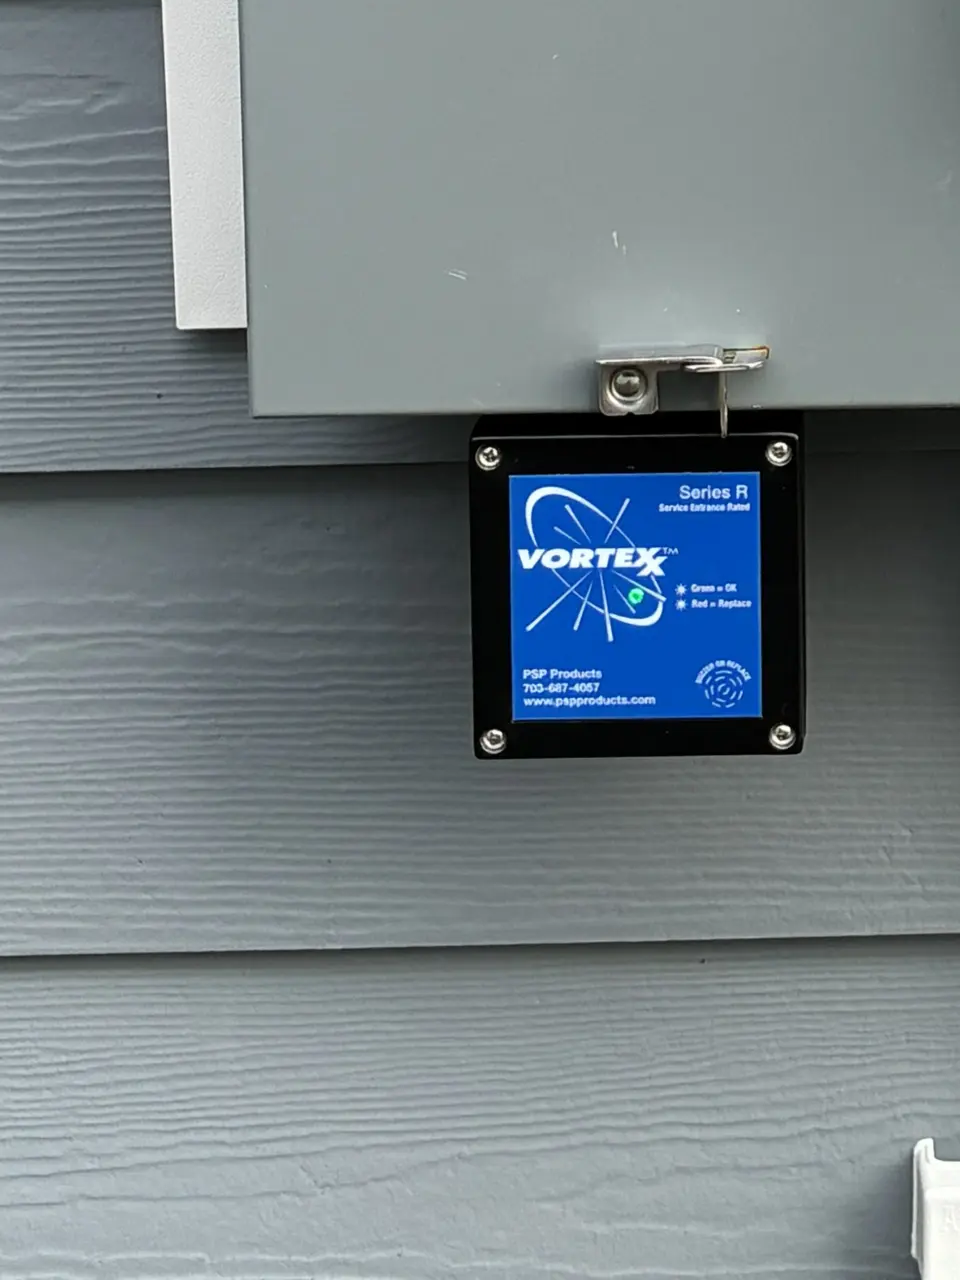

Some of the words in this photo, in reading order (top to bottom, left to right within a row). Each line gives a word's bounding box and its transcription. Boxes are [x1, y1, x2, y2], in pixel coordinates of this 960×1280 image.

[679, 484, 731, 500] Series
[736, 484, 748, 500] R
[659, 503, 689, 513] Service
[690, 503, 725, 512] Entrance
[727, 502, 751, 512] Rated
[690, 583, 715, 593] Green
[725, 583, 737, 593] OK
[691, 599, 708, 609] Red
[718, 599, 752, 610] Replace
[522, 669, 548, 680] PSP
[549, 668, 603, 680] Products
[522, 682, 601, 694] 703-687-4057
[523, 695, 656, 708] www.pspproducts.com
